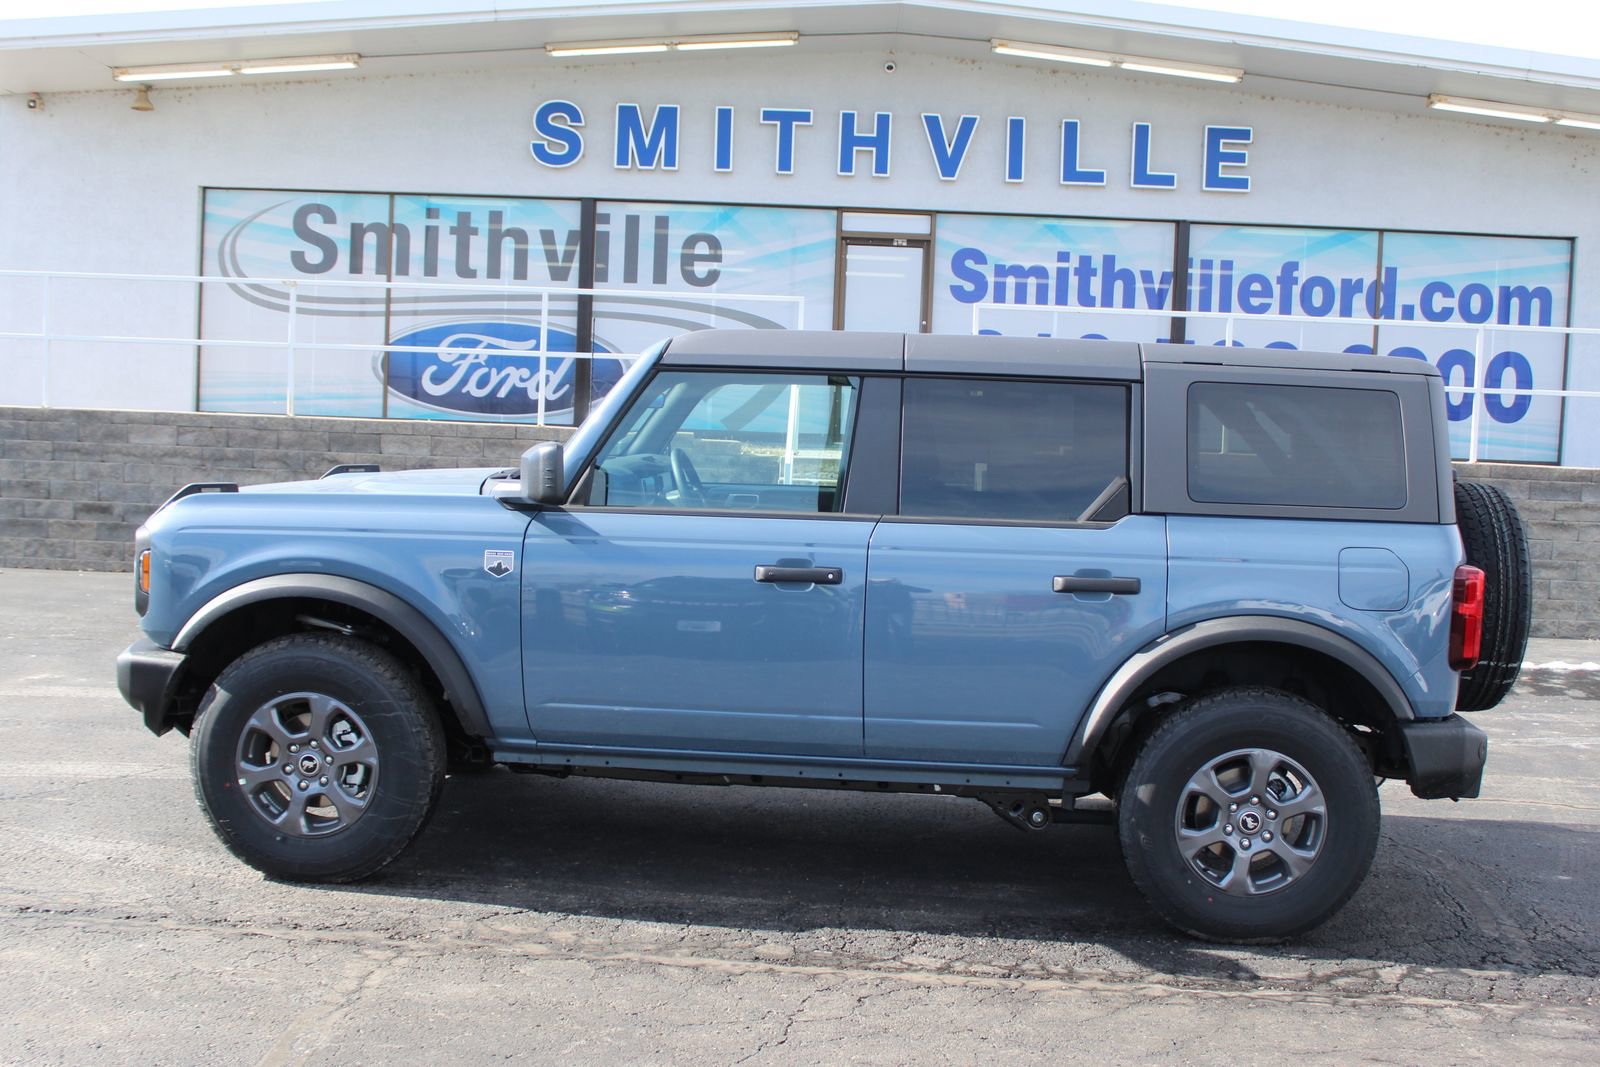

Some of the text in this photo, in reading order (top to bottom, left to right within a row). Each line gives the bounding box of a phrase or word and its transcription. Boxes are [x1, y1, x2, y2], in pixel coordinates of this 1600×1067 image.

[529, 100, 1254, 193] SMITHVILLE
[290, 203, 724, 287] Smithville
[421, 333, 575, 400] Ford
